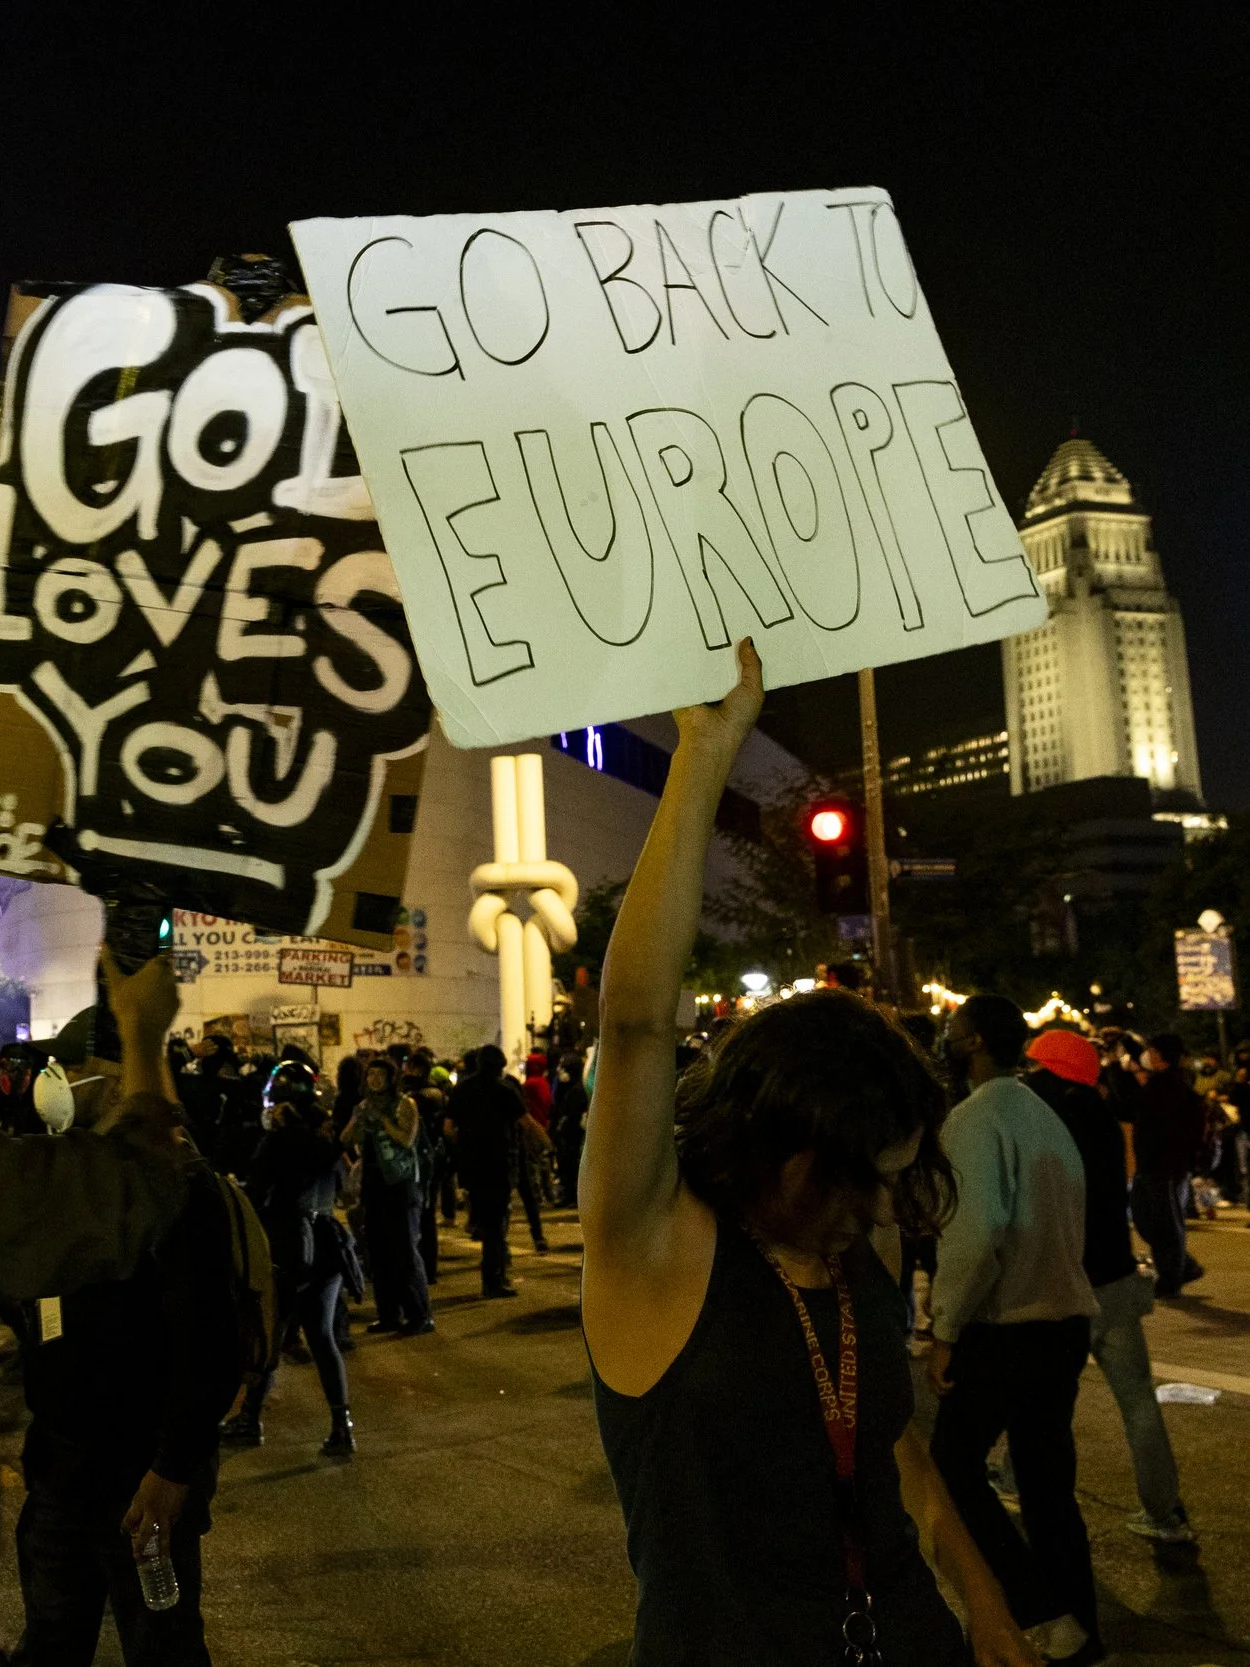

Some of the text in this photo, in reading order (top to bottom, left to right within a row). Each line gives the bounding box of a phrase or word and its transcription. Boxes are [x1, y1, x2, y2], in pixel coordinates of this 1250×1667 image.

[348, 201, 919, 382] GO BACK TO
[400, 380, 1039, 687] EUROPE
[30, 660, 340, 828] YOU
[193, 931, 236, 945] YOU
[279, 970, 349, 984] MARKET
[281, 950, 350, 964] PARKING
[775, 1266, 842, 1422] MARINE CORPS
[839, 1350, 858, 1429] UNITED
